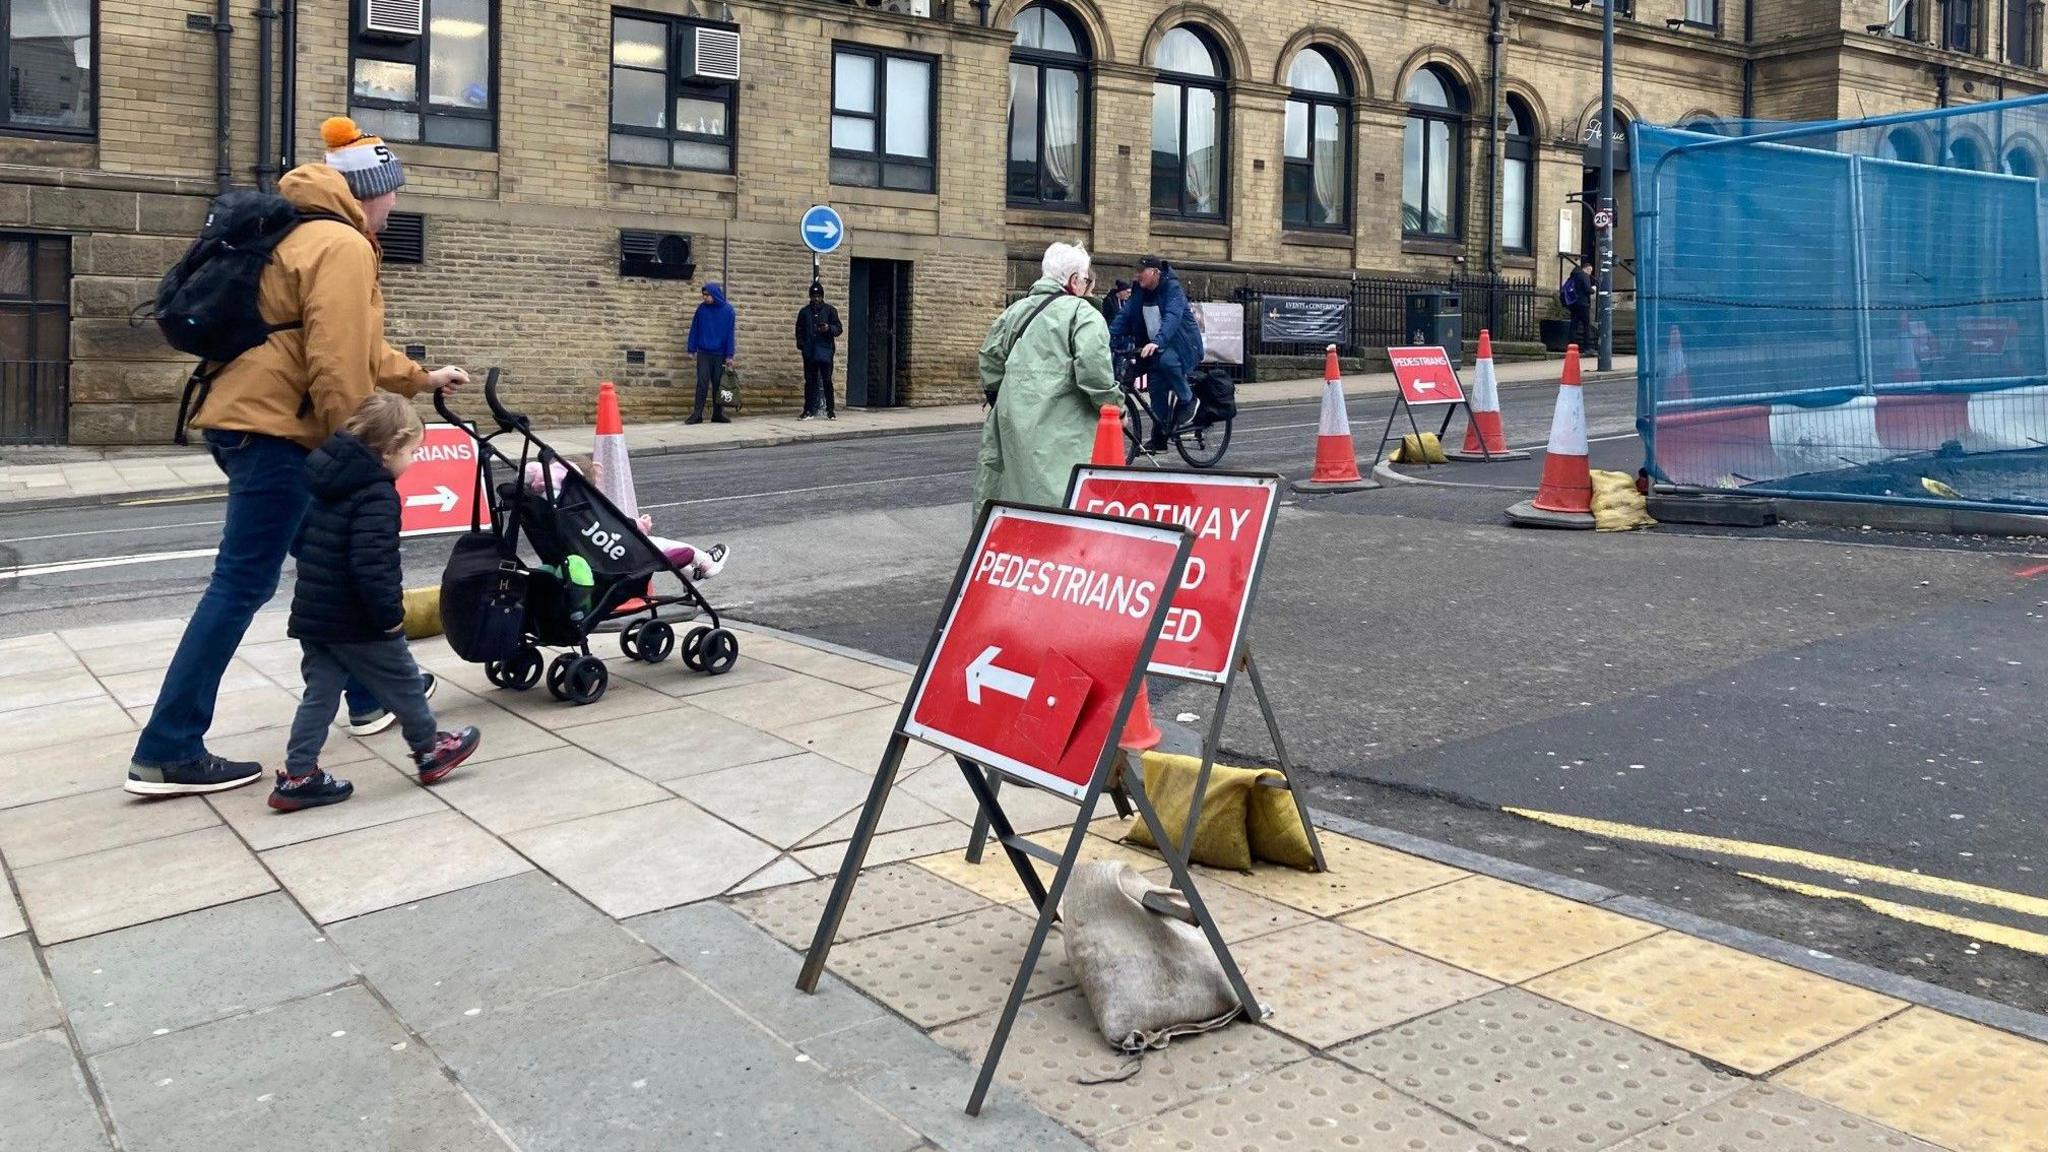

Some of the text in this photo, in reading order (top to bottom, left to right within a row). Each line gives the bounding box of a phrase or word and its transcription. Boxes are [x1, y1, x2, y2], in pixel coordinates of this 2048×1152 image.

[374, 145, 394, 164] S
[1595, 214, 1608, 224] 20
[1394, 356, 1447, 367] PEDESTRIANS
[581, 521, 626, 560] Joie
[975, 550, 1156, 619] PEDESTRIANS
